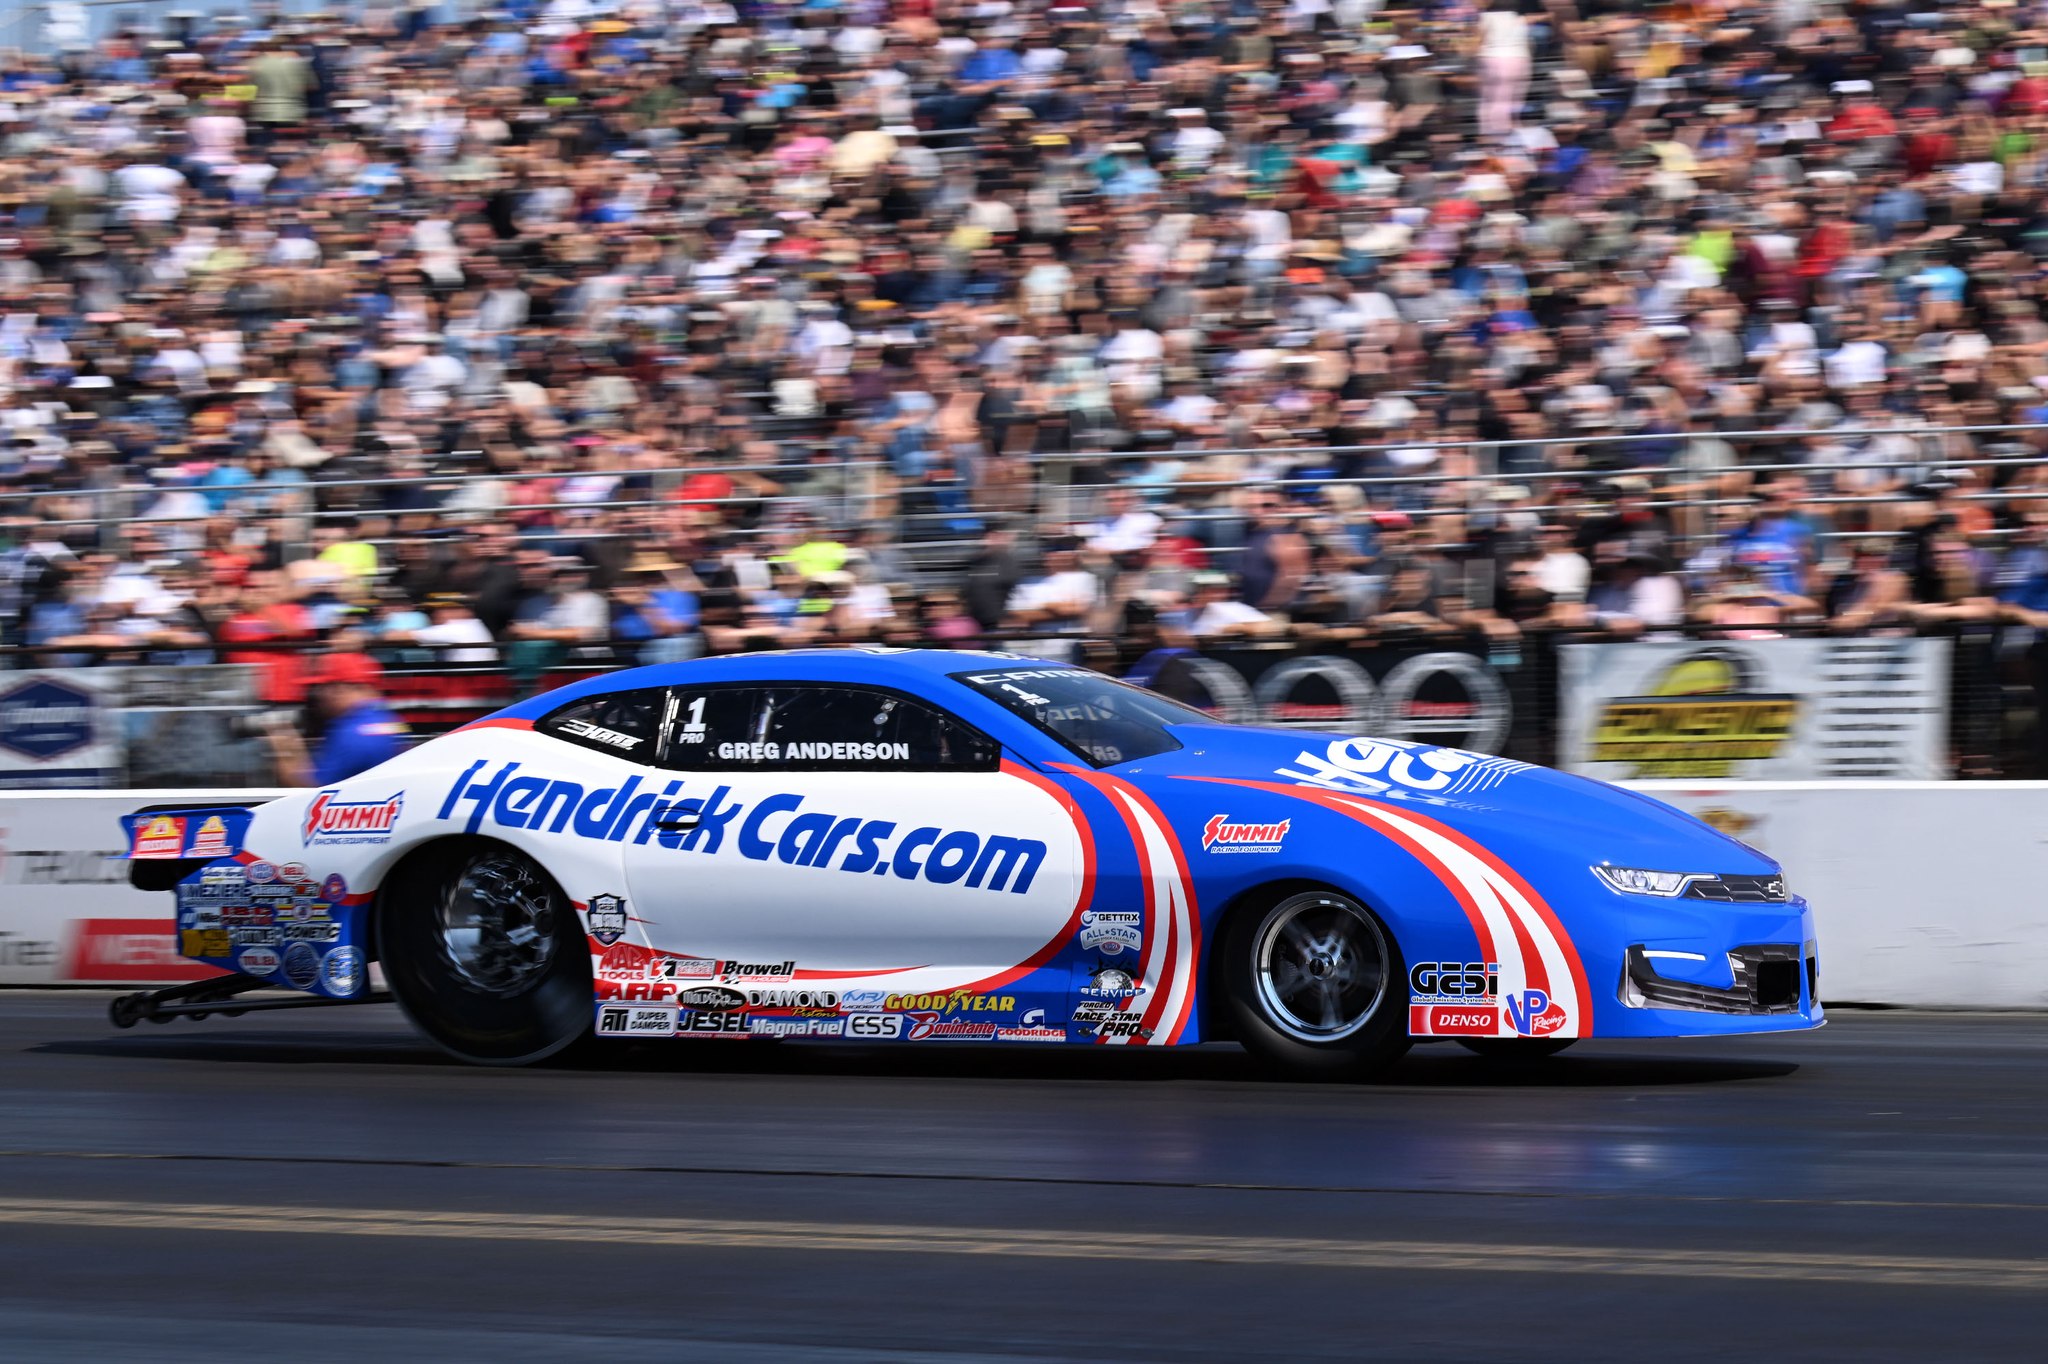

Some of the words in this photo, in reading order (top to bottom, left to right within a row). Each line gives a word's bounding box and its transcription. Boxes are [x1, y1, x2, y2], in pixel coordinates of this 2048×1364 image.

[683, 697, 707, 732] 1
[679, 732, 705, 744] PRO
[718, 742, 781, 760] GREG
[785, 742, 910, 760] ANDERSON
[1098, 913, 1138, 921] GETTRX
[598, 971, 645, 980] TOOLS
[722, 960, 796, 976] Browell
[597, 983, 677, 1001] ARP
[748, 990, 839, 1008] DIAMOND
[601, 1009, 629, 1031] ATI
[636, 1011, 668, 1020] SUPER
[791, 1007, 839, 1018] Pistons
[1073, 1011, 1106, 1021] RACE
[1111, 1012, 1142, 1022] STAR
[1439, 1014, 1491, 1026] DENSO
[1506, 990, 1548, 1035] VP
[631, 1021, 670, 1030] DAMPER
[677, 1012, 752, 1032] JESEL
[750, 1018, 844, 1038] MagnaFuel
[852, 1015, 897, 1035] ESS
[1100, 1022, 1142, 1036] PRO
[1533, 1016, 1567, 1031] Racing
[998, 1028, 1066, 1037] GOODRIDGE
